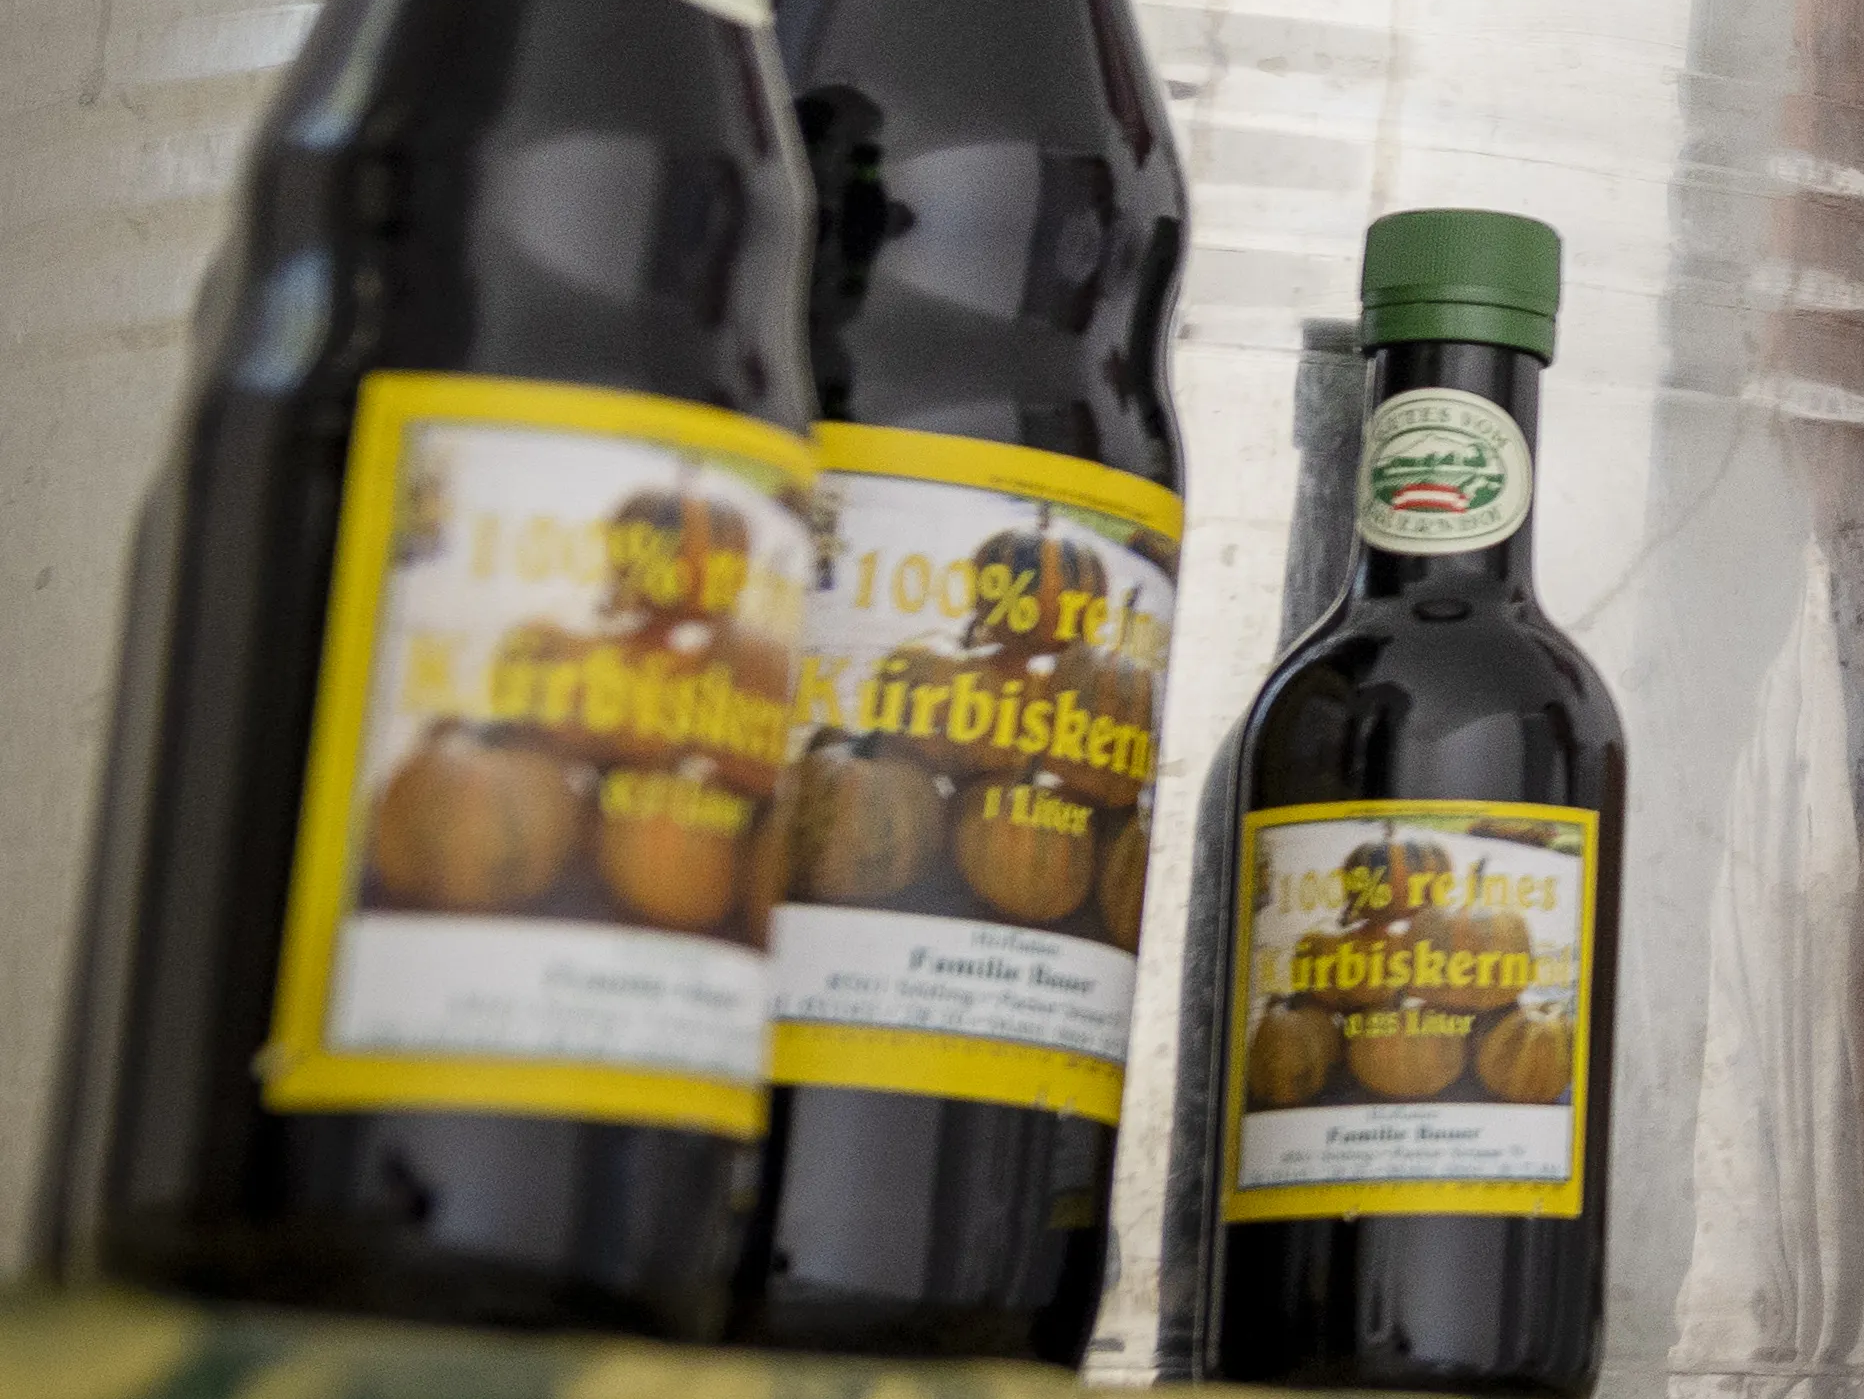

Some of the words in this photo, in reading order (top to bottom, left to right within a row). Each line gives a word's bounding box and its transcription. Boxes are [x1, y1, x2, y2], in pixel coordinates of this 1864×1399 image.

[852, 550, 1041, 634] 100%
[1278, 864, 1393, 915] 100%
[1406, 857, 1558, 912] reines
